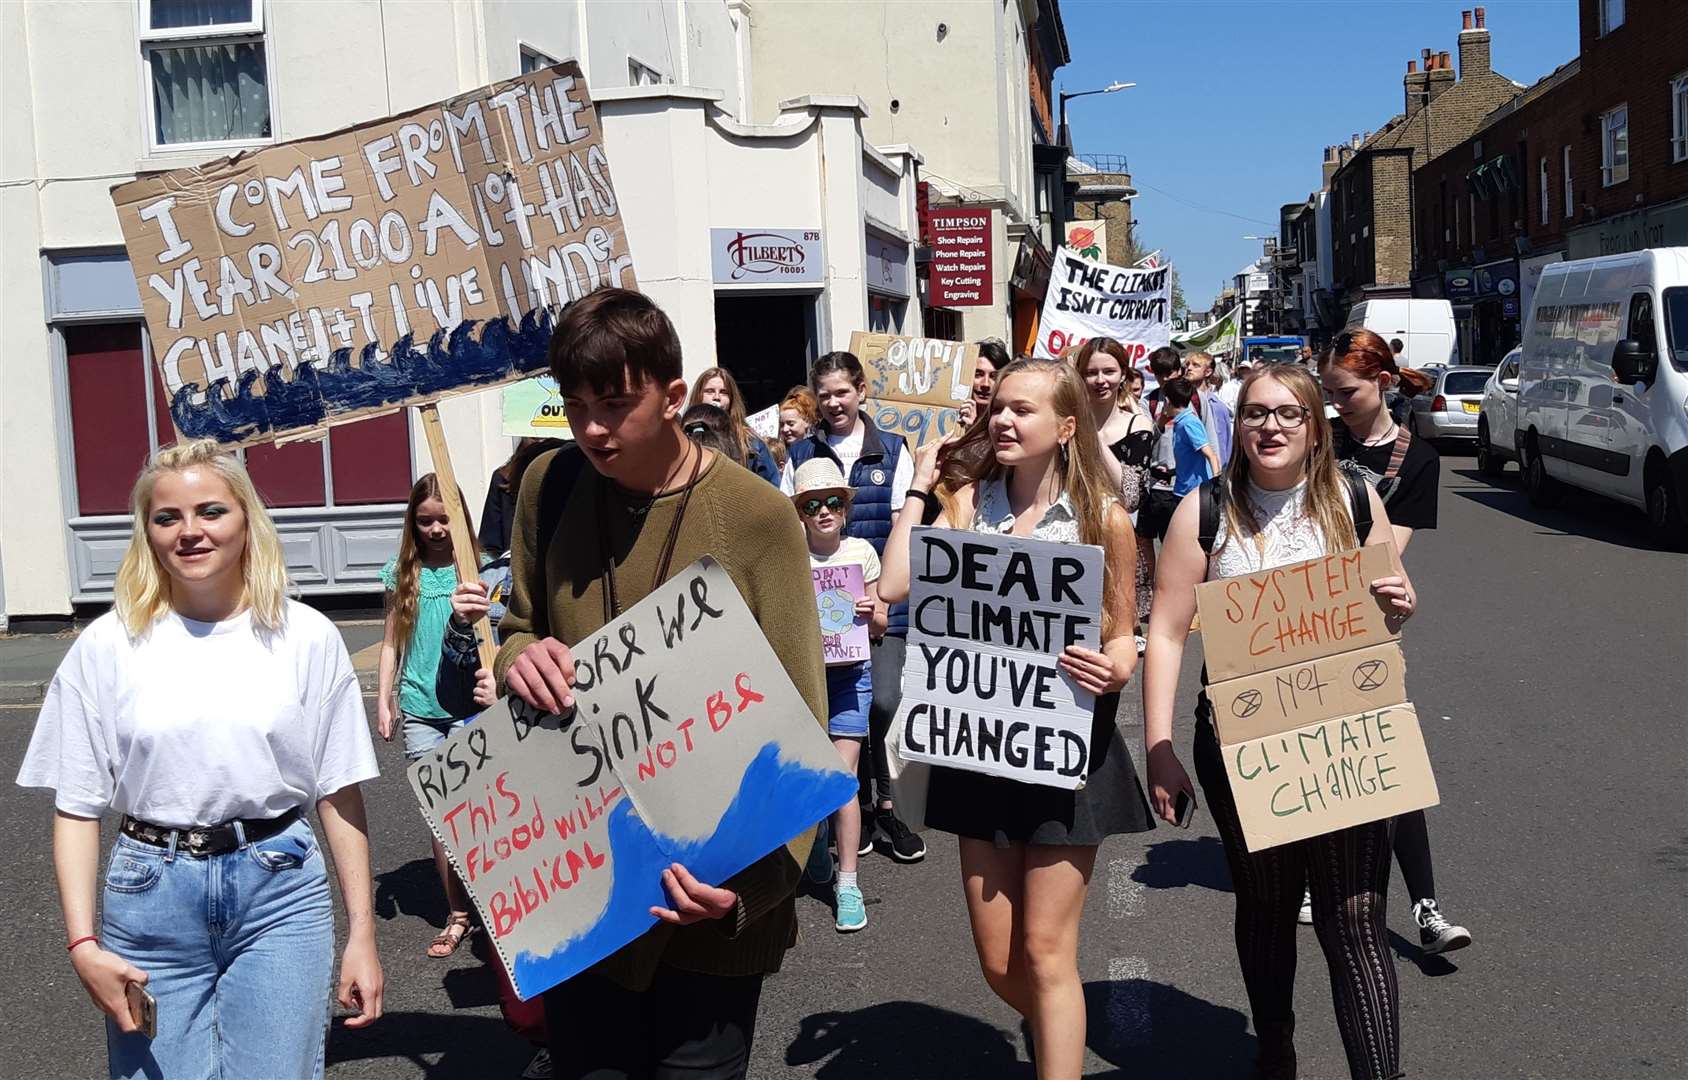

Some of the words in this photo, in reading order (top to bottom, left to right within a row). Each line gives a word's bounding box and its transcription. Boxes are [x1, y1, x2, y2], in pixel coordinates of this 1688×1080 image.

[138, 197, 193, 264] I
[215, 155, 353, 238] COME
[363, 102, 498, 203] FROM
[488, 75, 591, 165] THE
[148, 242, 294, 329] YEAR
[287, 208, 414, 283] 2100
[418, 188, 481, 256] A
[538, 144, 619, 235] HAS
[803, 231, 820, 241] 87B
[933, 217, 987, 228] TIMPSON
[937, 236, 956, 245] Shoe
[957, 235, 983, 246] Repairs
[727, 231, 805, 280] FILBERTS
[780, 266, 806, 274] FOODS
[935, 250, 958, 258] Phone
[959, 249, 986, 260] Repairs
[935, 264, 959, 272] Watch
[959, 263, 986, 273] Repairs
[1066, 256, 1109, 292] THE
[941, 278, 954, 287] Key
[955, 277, 982, 287] Cutting
[944, 290, 980, 301] Engraving
[1056, 286, 1109, 315] ISN'T
[1109, 297, 1167, 323] CORRUPT
[916, 536, 1085, 606] DEAR
[1225, 551, 1365, 624] SYSTEM
[915, 594, 1092, 654] CLIMATE
[1248, 602, 1367, 657] CHANGE
[919, 642, 1058, 710] YOU'VE
[638, 717, 695, 782] NOT
[904, 703, 1088, 782] CHANGED.
